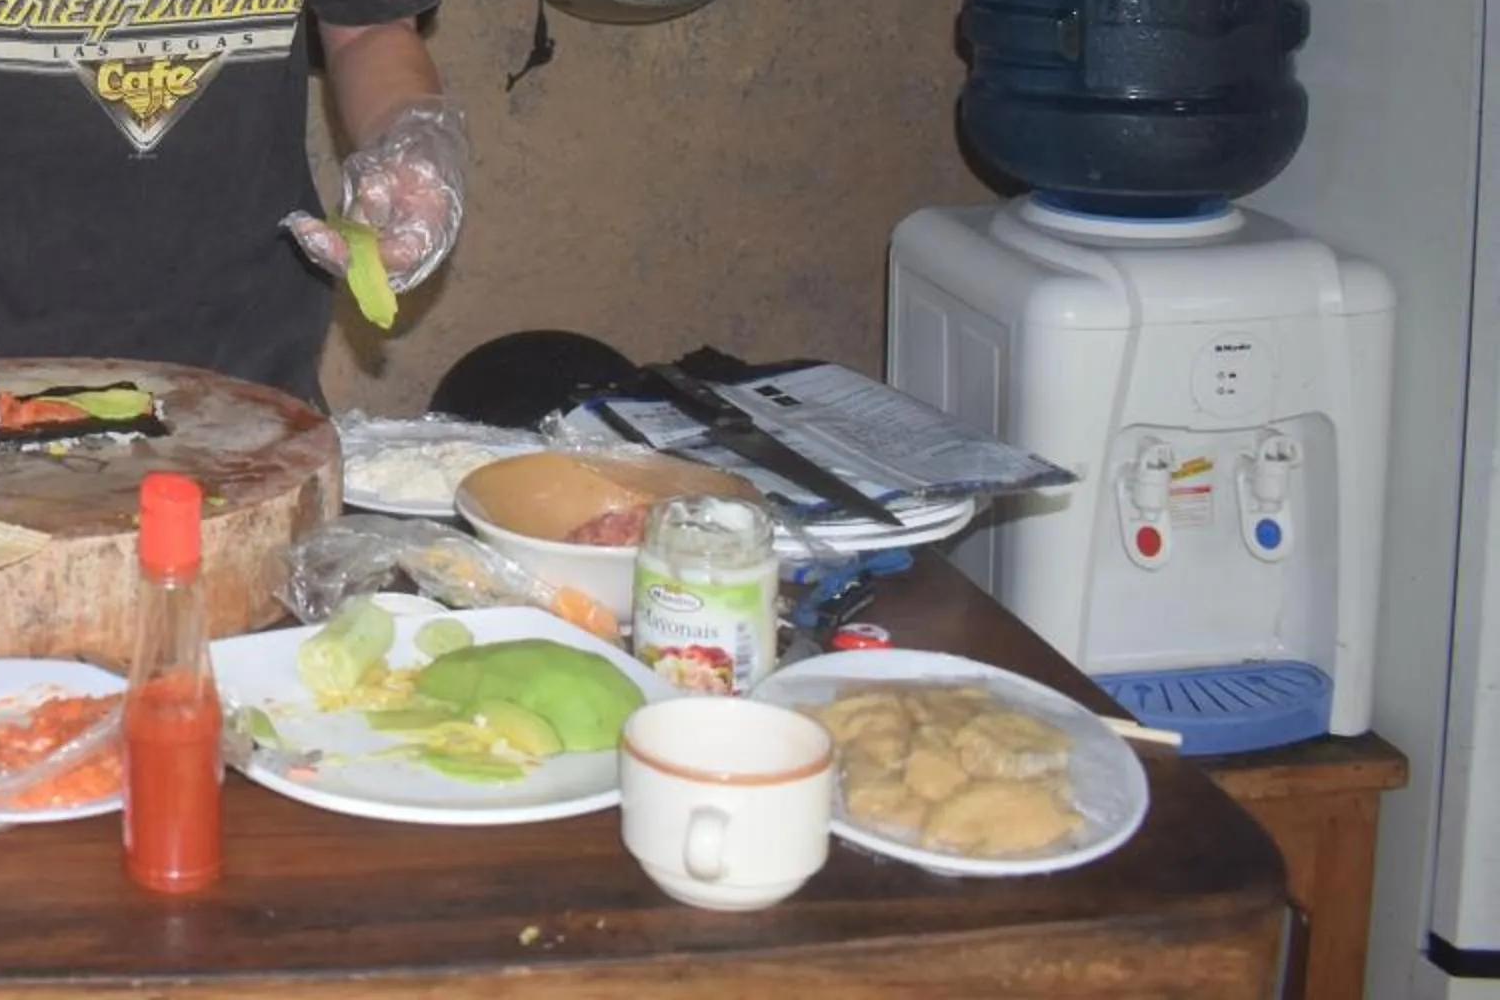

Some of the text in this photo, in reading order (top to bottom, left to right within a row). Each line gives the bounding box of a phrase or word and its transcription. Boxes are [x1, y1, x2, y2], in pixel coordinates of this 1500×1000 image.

[52, 33, 254, 59] LAS VEGAS
[98, 56, 197, 101] Cafe
